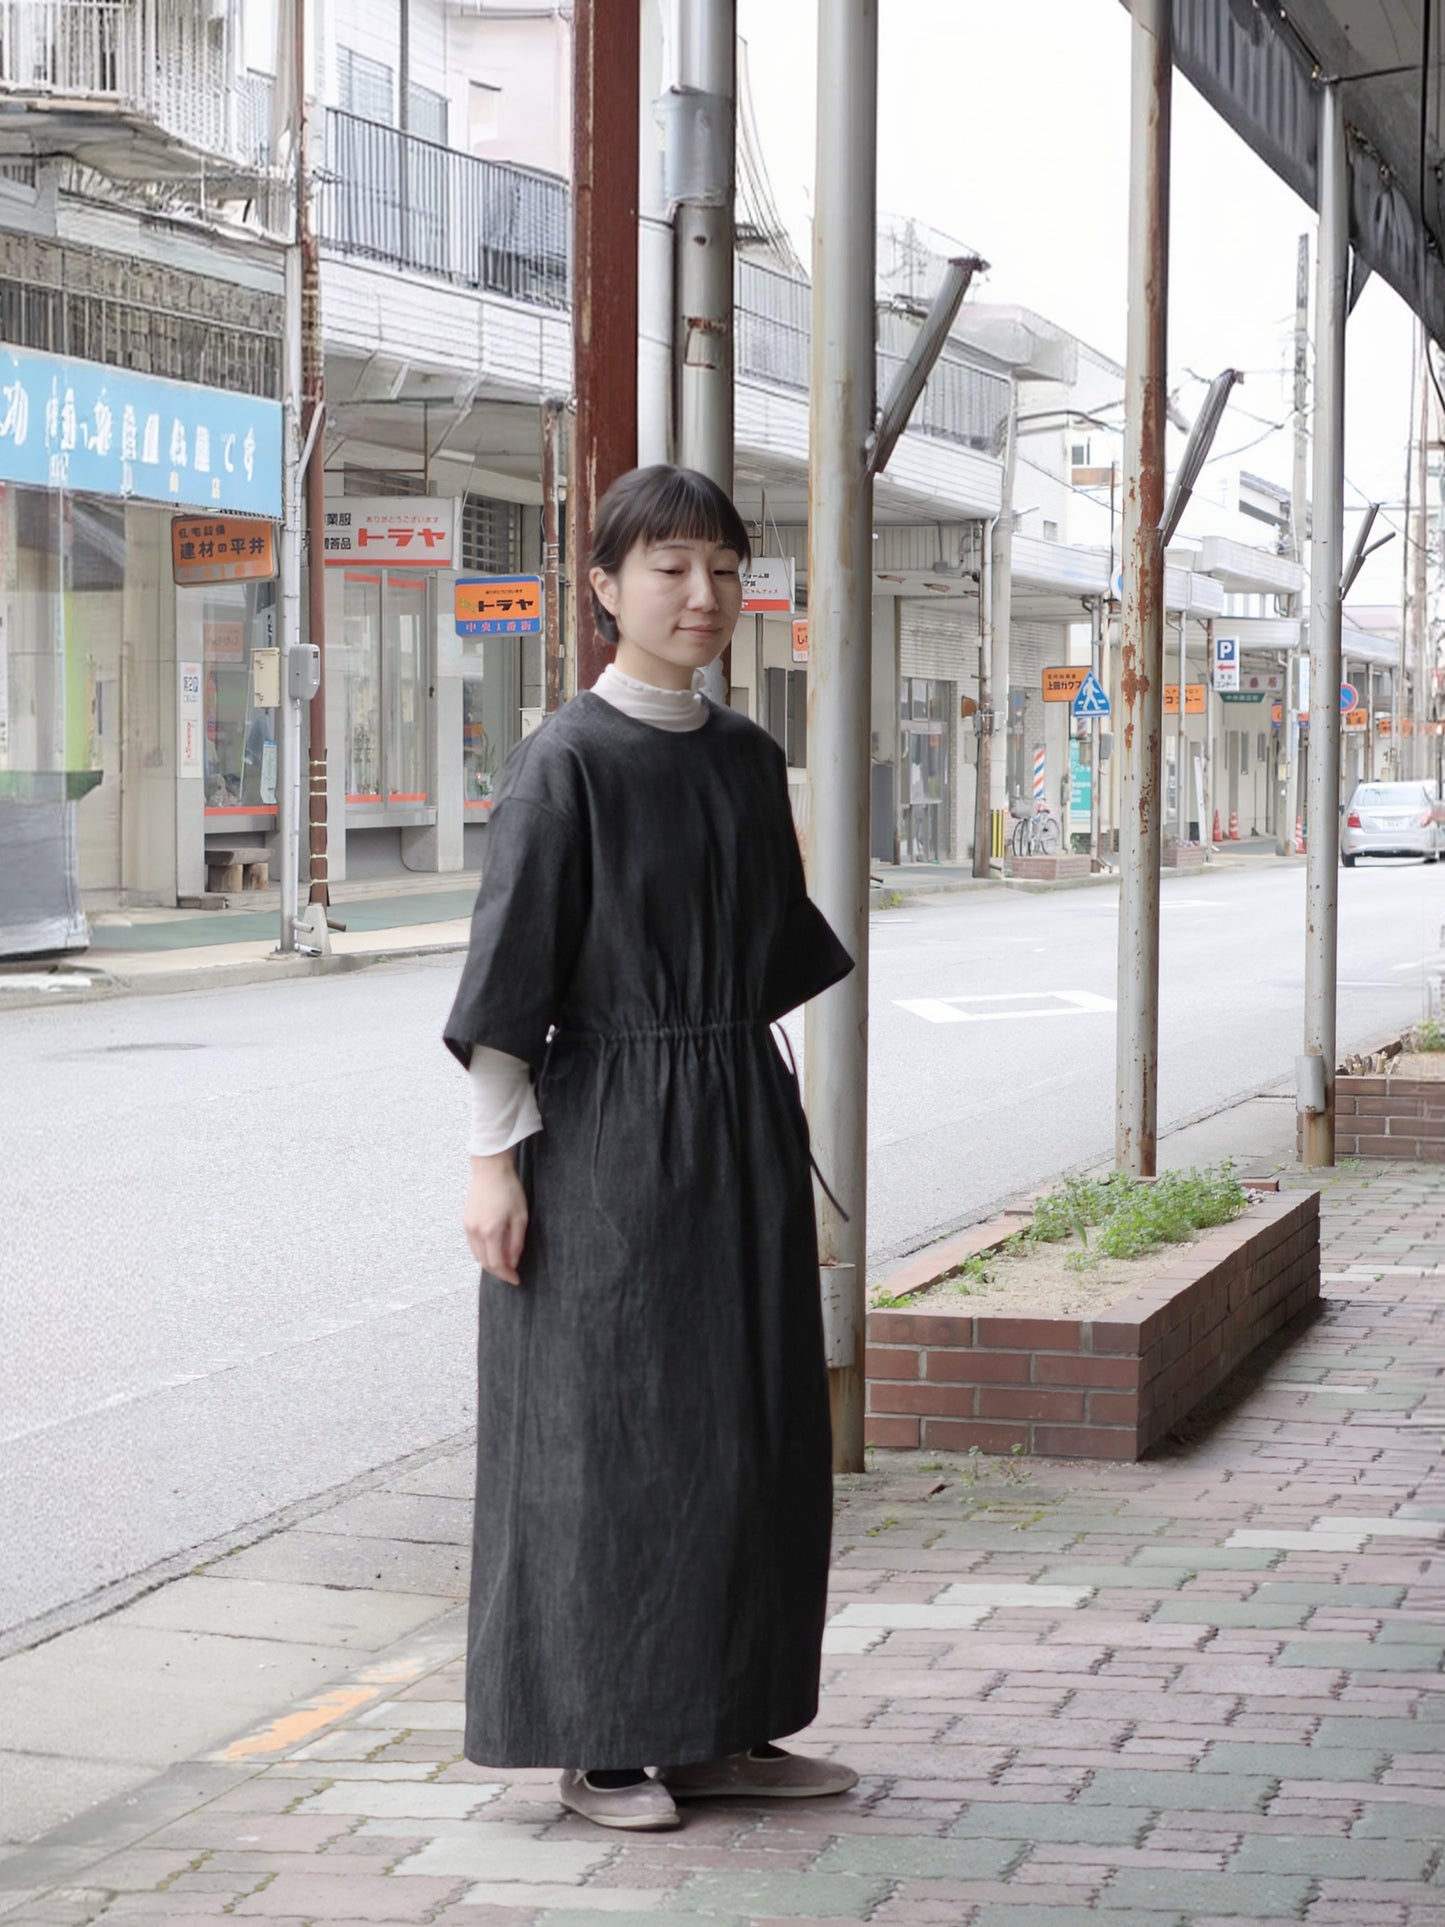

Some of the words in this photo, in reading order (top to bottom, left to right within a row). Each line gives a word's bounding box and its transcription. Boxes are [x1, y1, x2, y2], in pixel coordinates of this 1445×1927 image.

[366, 515, 439, 523] ありがとうございます
[358, 527, 446, 548] トラヤ
[180, 537, 265, 560] 建材の平井
[478, 599, 534, 612] トラヤ
[1220, 641, 1233, 660] P
